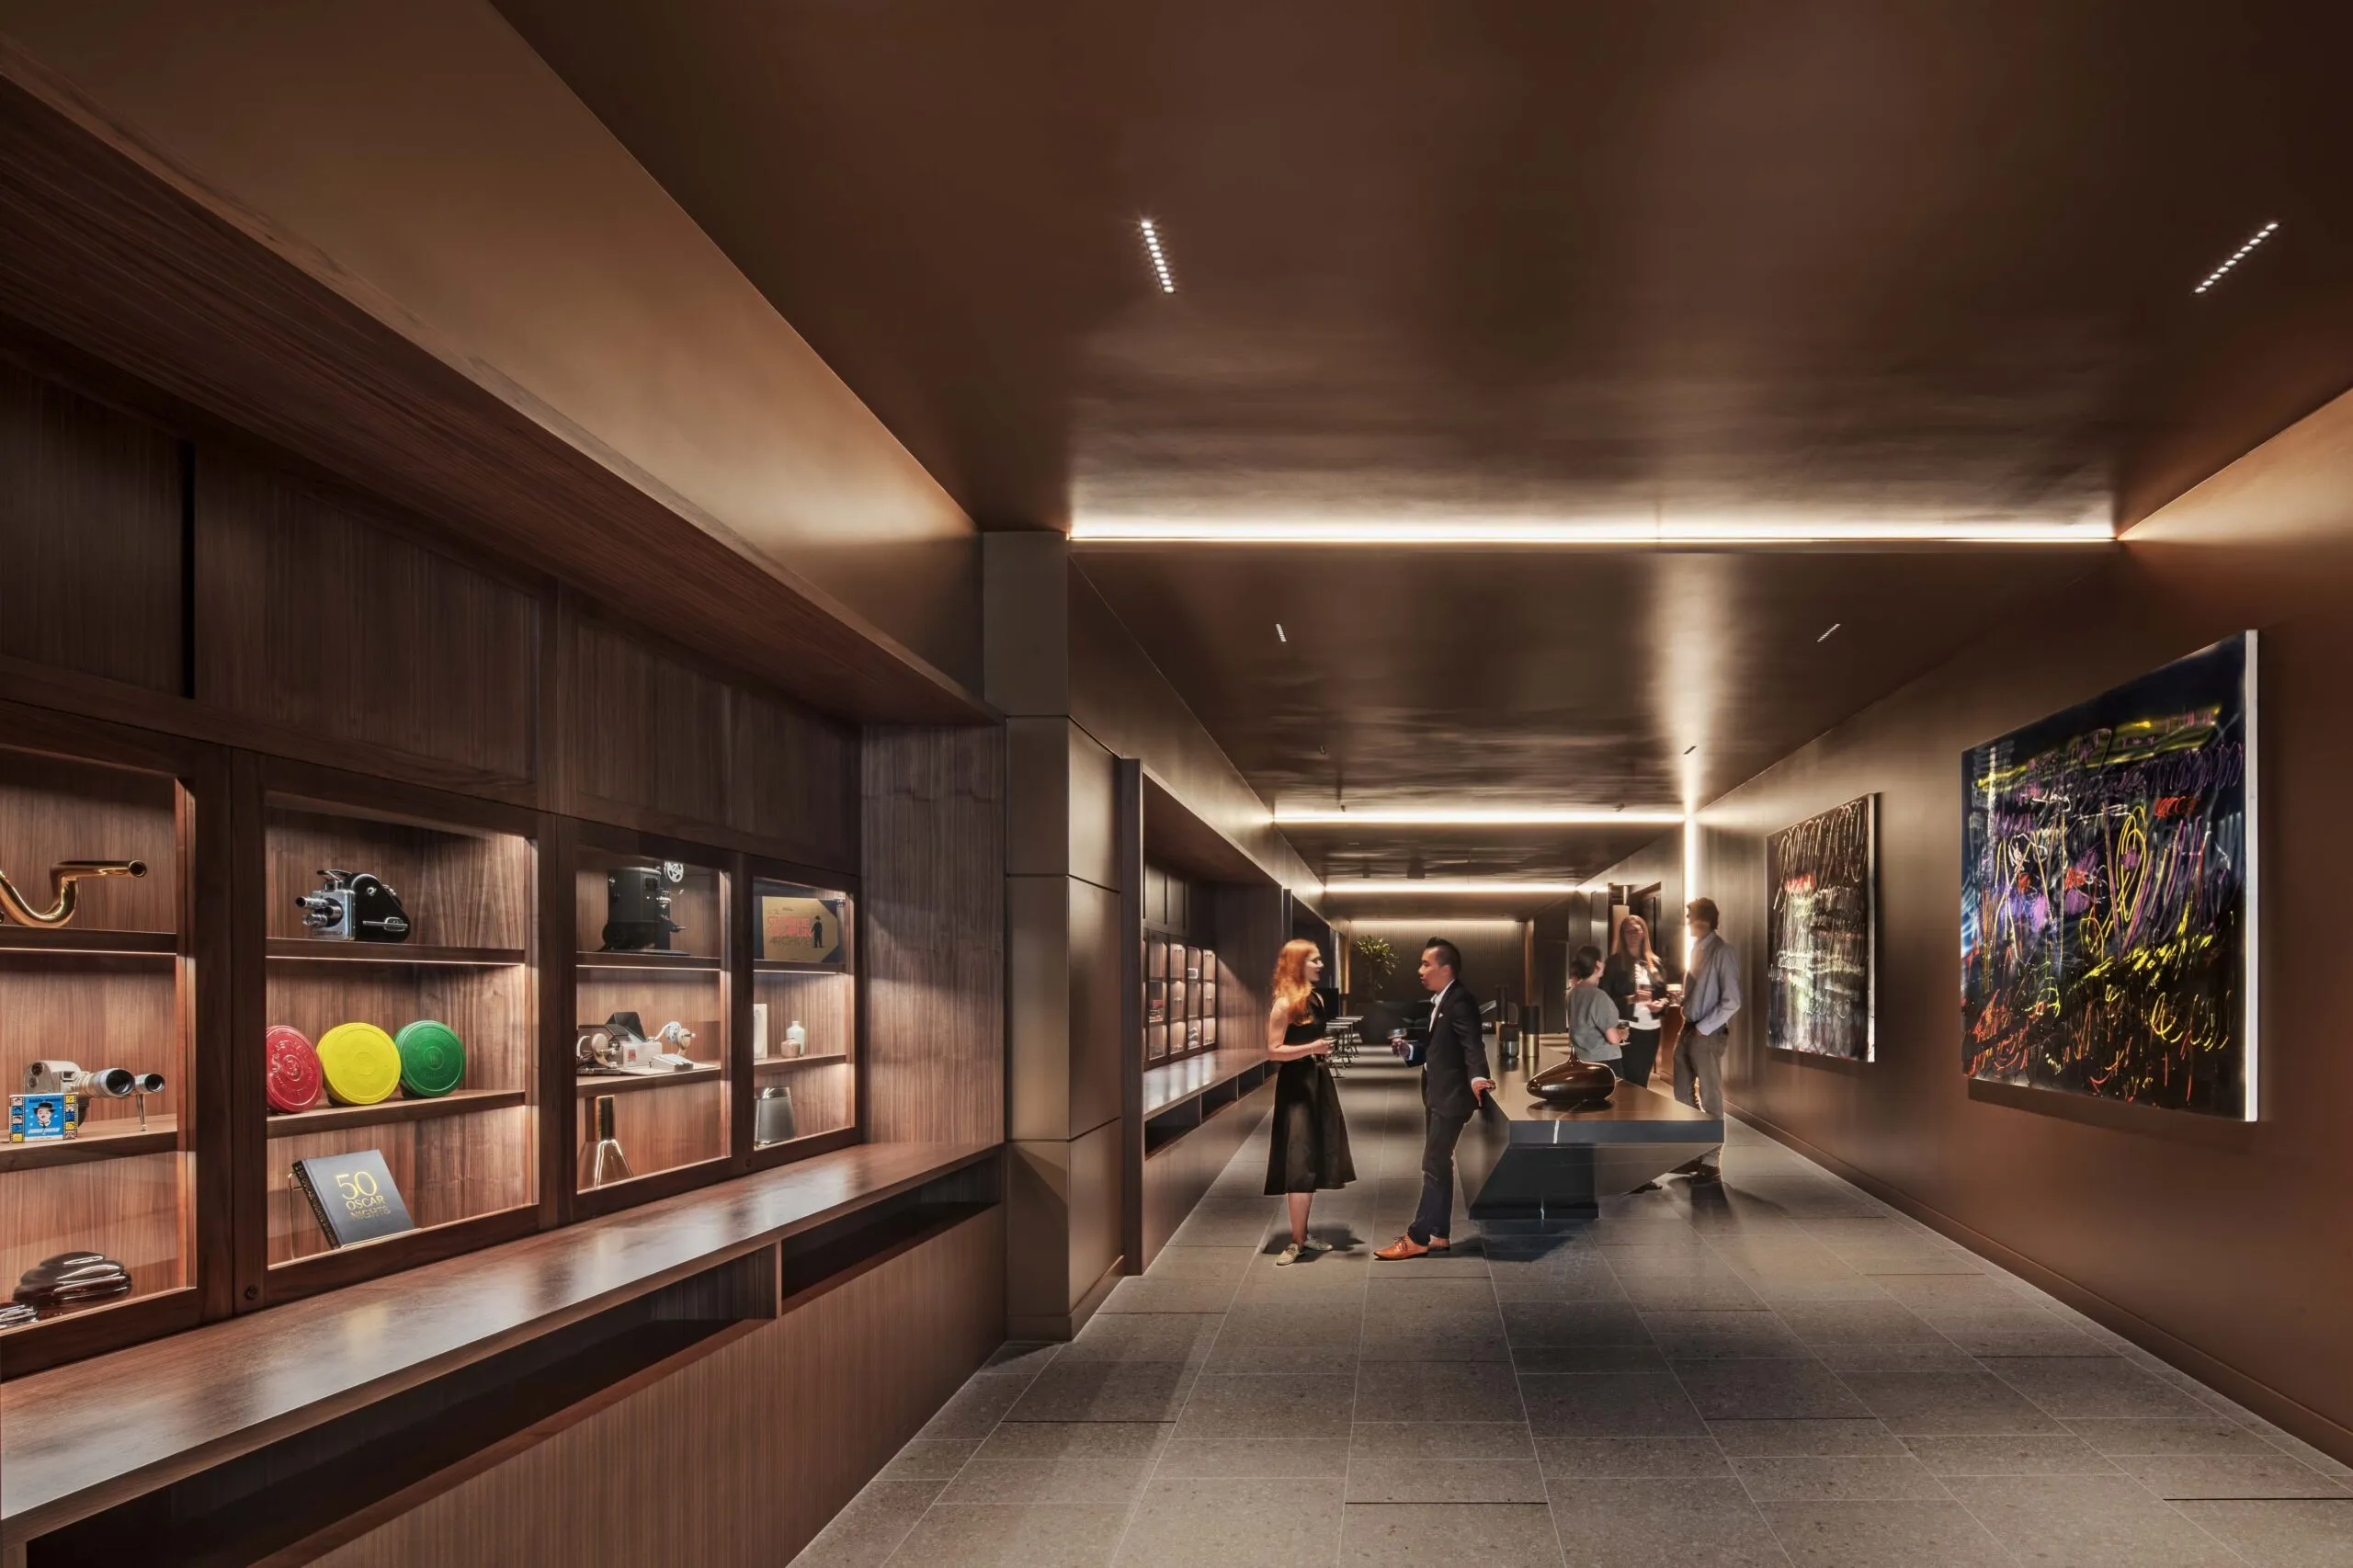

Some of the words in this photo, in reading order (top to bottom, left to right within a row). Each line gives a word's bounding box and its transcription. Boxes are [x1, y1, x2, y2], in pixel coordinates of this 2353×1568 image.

[336, 1171, 378, 1199] 50
[346, 1195, 385, 1210] OSCAR
[350, 1205, 391, 1220] NIGHTS
